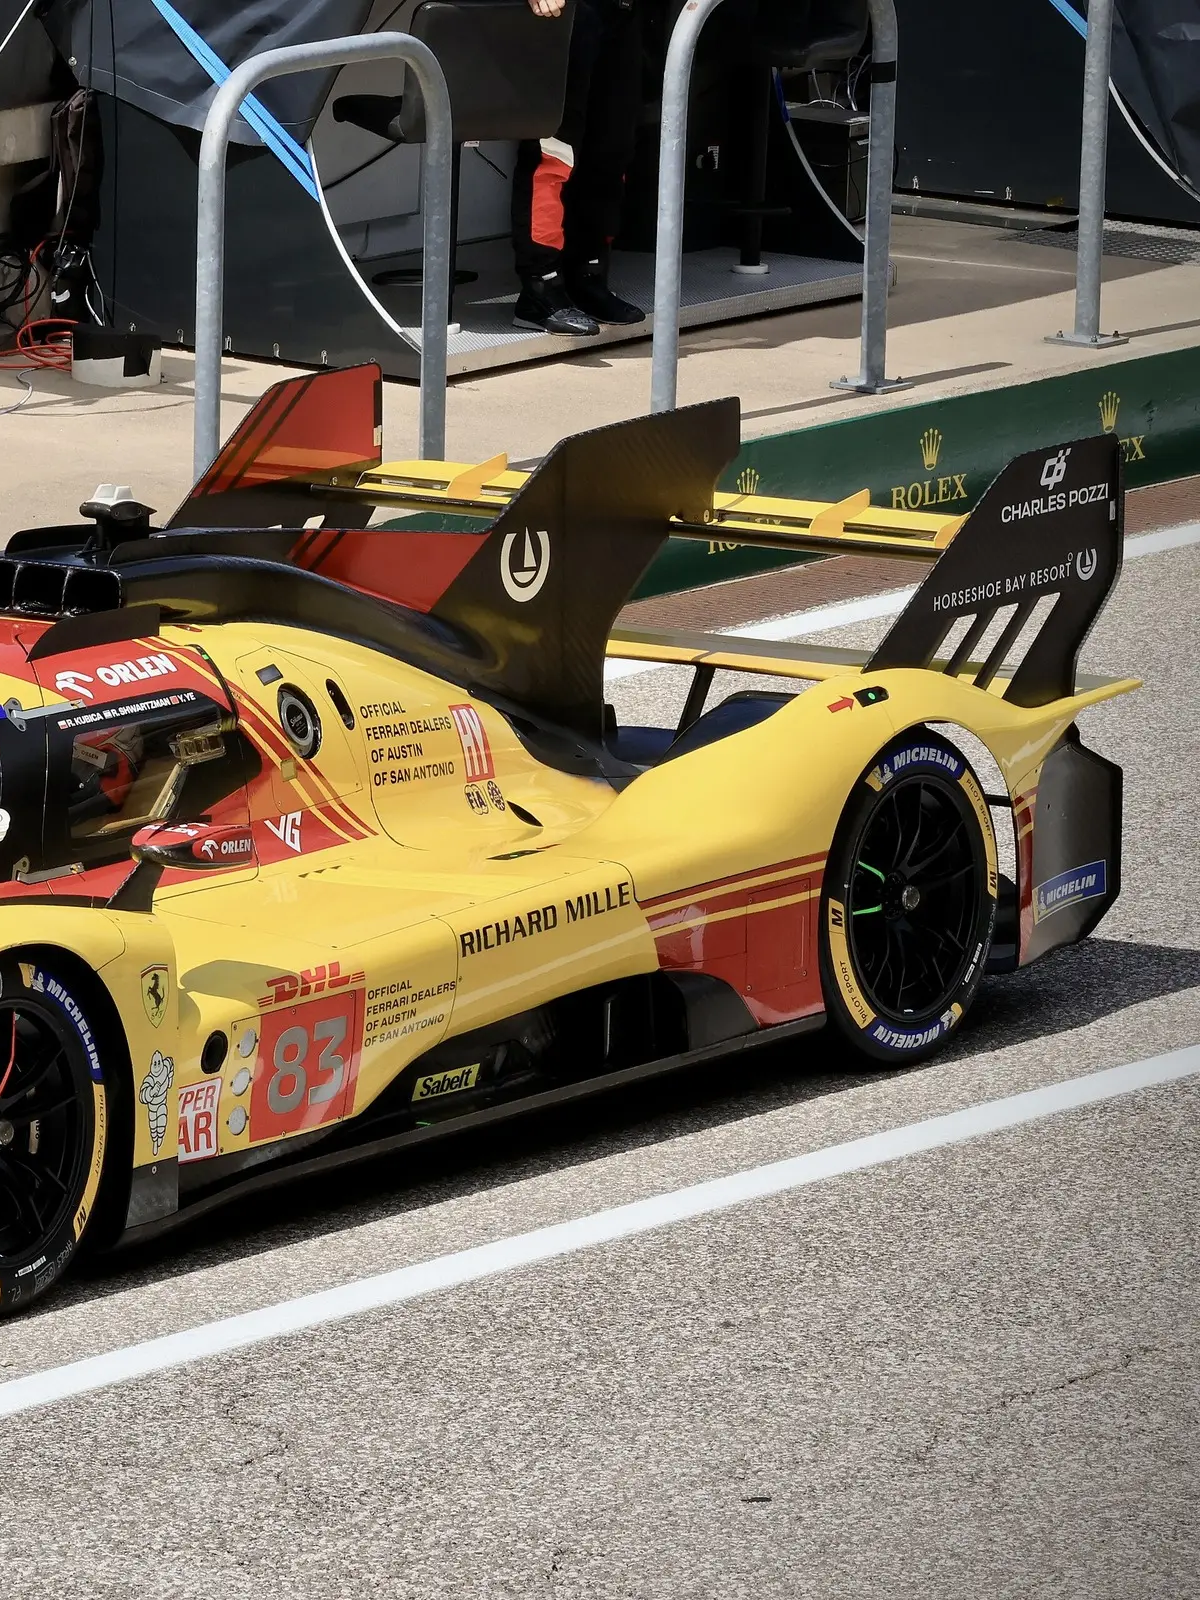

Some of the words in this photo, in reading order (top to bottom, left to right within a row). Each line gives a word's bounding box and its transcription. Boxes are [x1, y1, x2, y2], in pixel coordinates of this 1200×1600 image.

[891, 473, 968, 510] ROLEX
[1001, 492, 1066, 523] CHARLES
[1069, 482, 1109, 508] POZZI
[933, 581, 1001, 612] HORSESHOE
[1005, 573, 1027, 593] BAY
[1030, 562, 1072, 587] RESORT
[96, 653, 178, 687] ORLEN
[359, 701, 406, 719] OFFICIAL
[365, 720, 410, 741] FERRARI
[411, 717, 452, 735] DEALERS
[452, 708, 488, 777] HY
[371, 748, 387, 764] OF
[387, 742, 423, 761] AUSTIN
[893, 746, 959, 772] MICHELIN
[373, 771, 389, 787] OF
[390, 768, 411, 783] SAN
[412, 761, 455, 780] ANTONIO
[465, 790, 487, 810] FIA
[966, 778, 981, 801] PILOT
[980, 804, 992, 839] SPORT
[220, 838, 251, 855] ORLEN
[1046, 873, 1097, 905] MICHELIN
[459, 904, 558, 958] RICHARD
[565, 881, 630, 924] MILLE
[831, 908, 843, 927] M
[266, 961, 352, 1004] DHL
[367, 979, 412, 1001] OFFICIAL
[839, 960, 855, 994] SPORT
[366, 995, 409, 1018] FERRARI
[411, 980, 456, 1004] DEALERS
[851, 996, 868, 1024] PILOT
[46, 979, 100, 1071] MICHELIN
[364, 1034, 378, 1048] OF
[378, 1028, 399, 1044] SAN
[400, 1013, 444, 1037] ANTONIO
[365, 1018, 380, 1032] OF
[380, 1008, 417, 1028] AUSTIN
[872, 1022, 940, 1050] MICHELIN
[267, 1015, 348, 1115] 83
[178, 1084, 216, 1114] PER
[419, 1068, 473, 1098] Sabelt
[177, 1111, 213, 1154] AR
[95, 1135, 104, 1178] SPORT
